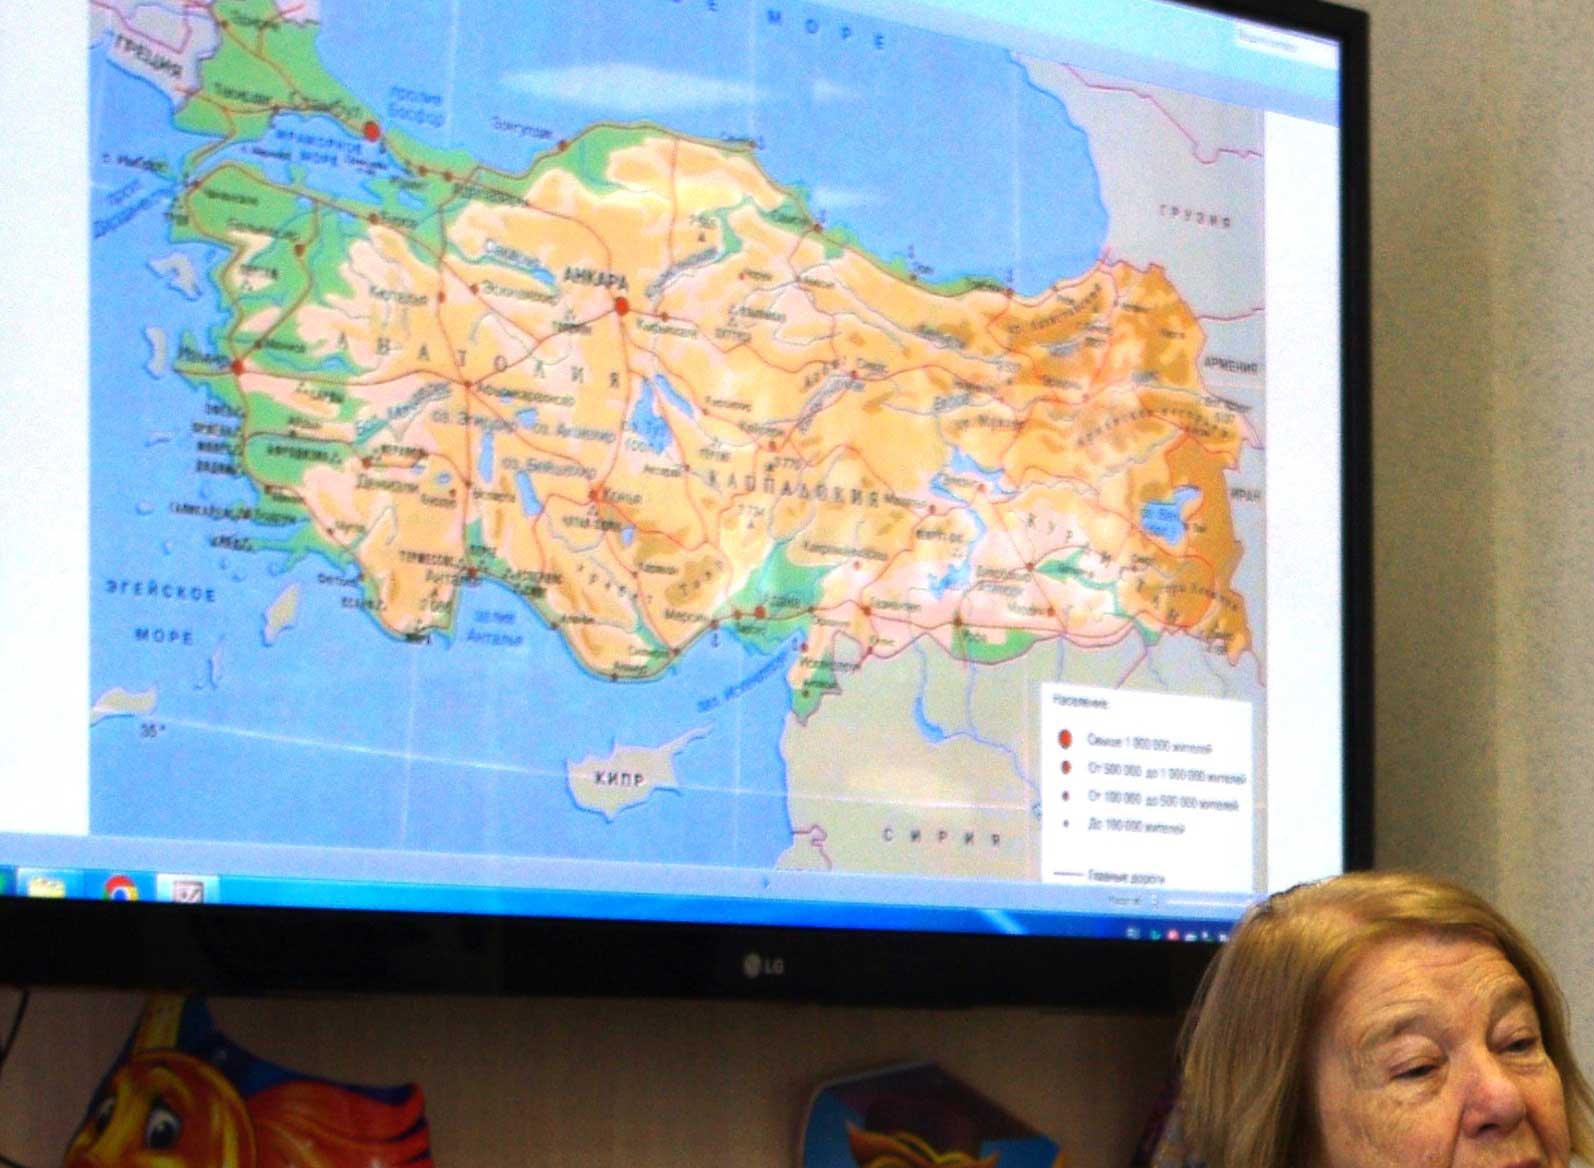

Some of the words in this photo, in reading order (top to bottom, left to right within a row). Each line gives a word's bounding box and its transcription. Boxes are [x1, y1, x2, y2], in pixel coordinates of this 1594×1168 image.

[767, 9, 884, 50] МОРЕ
[115, 33, 182, 77] ГРЕЦИЯ
[1159, 203, 1232, 229] ГРУЗИЯ
[564, 265, 629, 291] АНКАРА
[1204, 354, 1258, 374] АРМЕНИЯ
[1230, 486, 1262, 501] ИРАН
[105, 578, 216, 603] ЭГЕЙСКОЕ
[135, 628, 193, 645] МОРЕ
[593, 770, 645, 788] КИПР
[883, 827, 1000, 846] СИРИЯ
